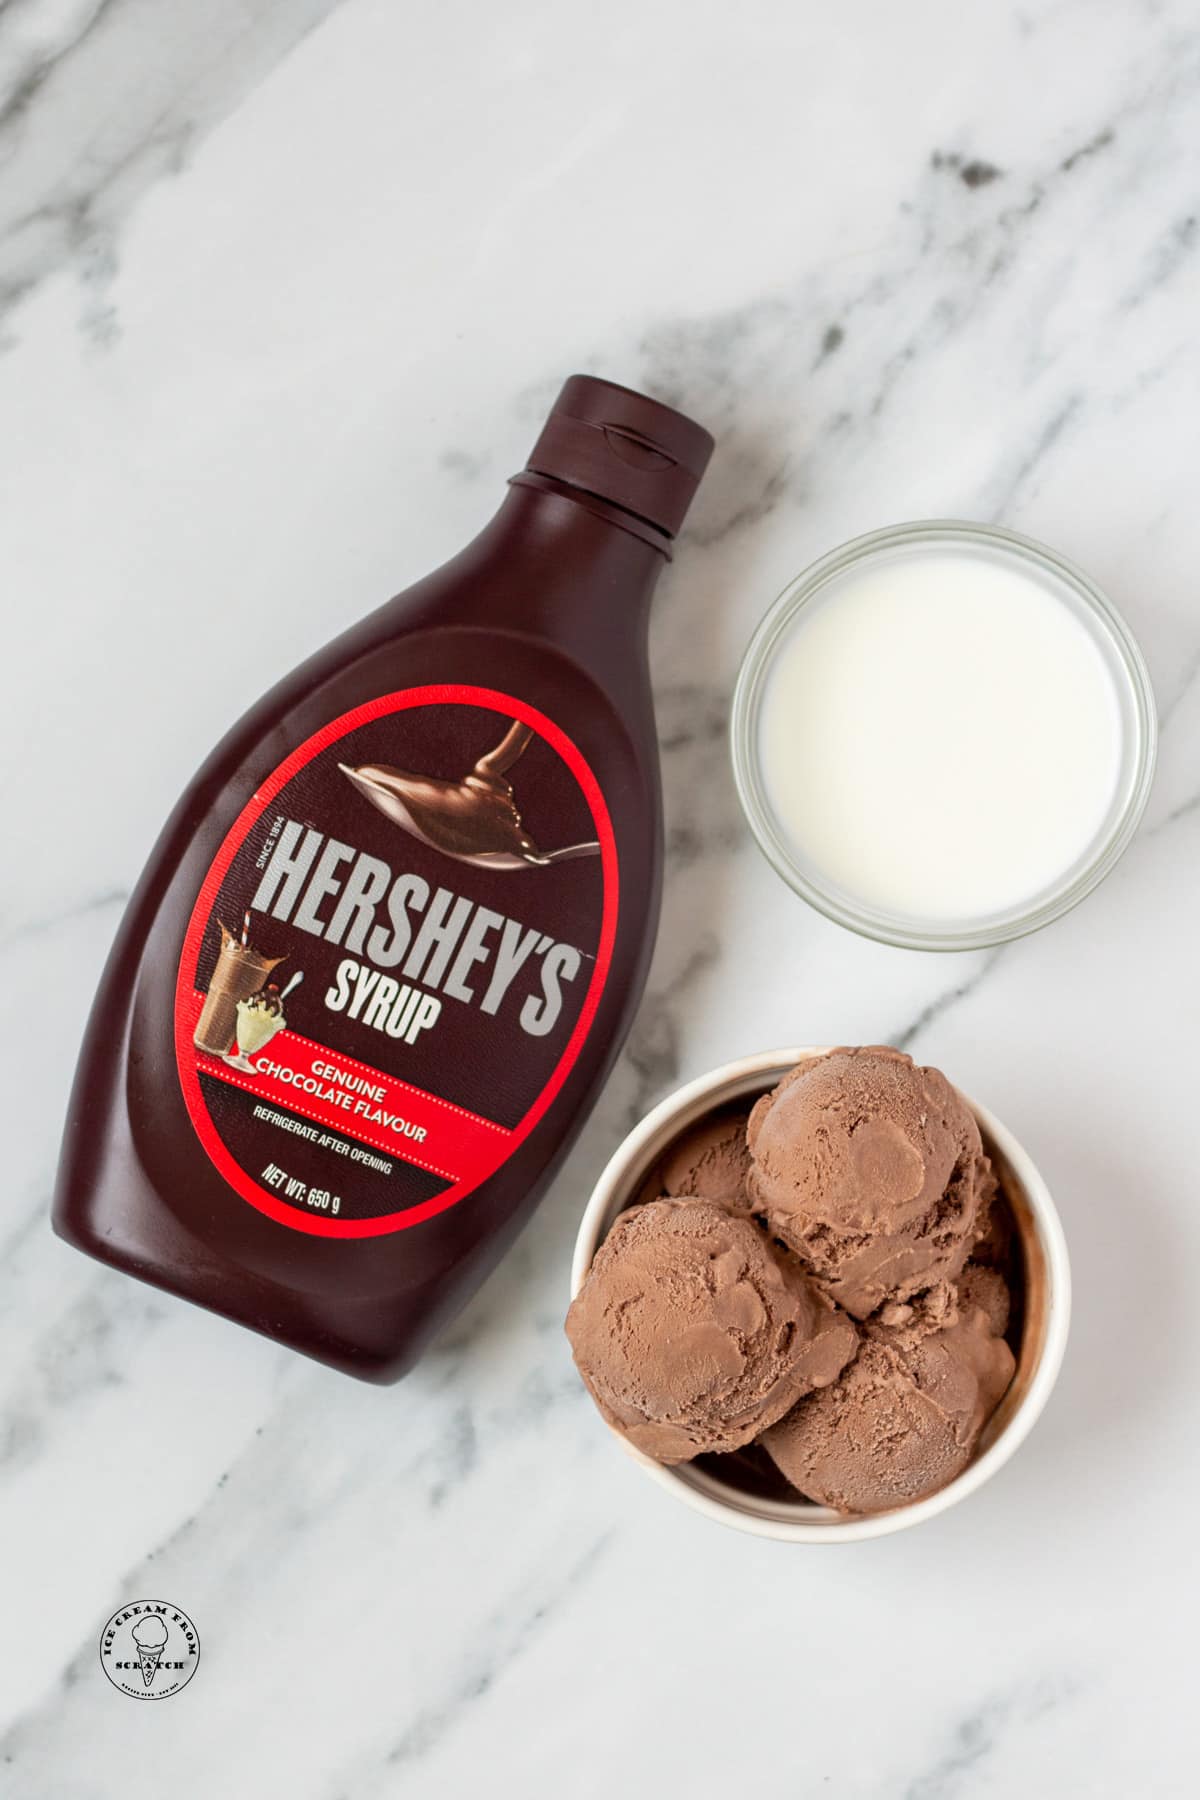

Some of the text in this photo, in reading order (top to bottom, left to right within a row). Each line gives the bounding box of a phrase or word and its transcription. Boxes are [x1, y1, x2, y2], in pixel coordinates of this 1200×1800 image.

[256, 816, 285, 870] SINCE 1894
[250, 819, 581, 1037] HERSHEY'S
[324, 958, 442, 1045] SYRUP
[256, 1057, 428, 1143] CHOCOLATE FLAVOUR
[311, 1060, 387, 1103] GENUINE
[253, 1105, 393, 1175] REFRIGERATE AFTER OPENING
[261, 1163, 341, 1214] NET WT: 650 g
